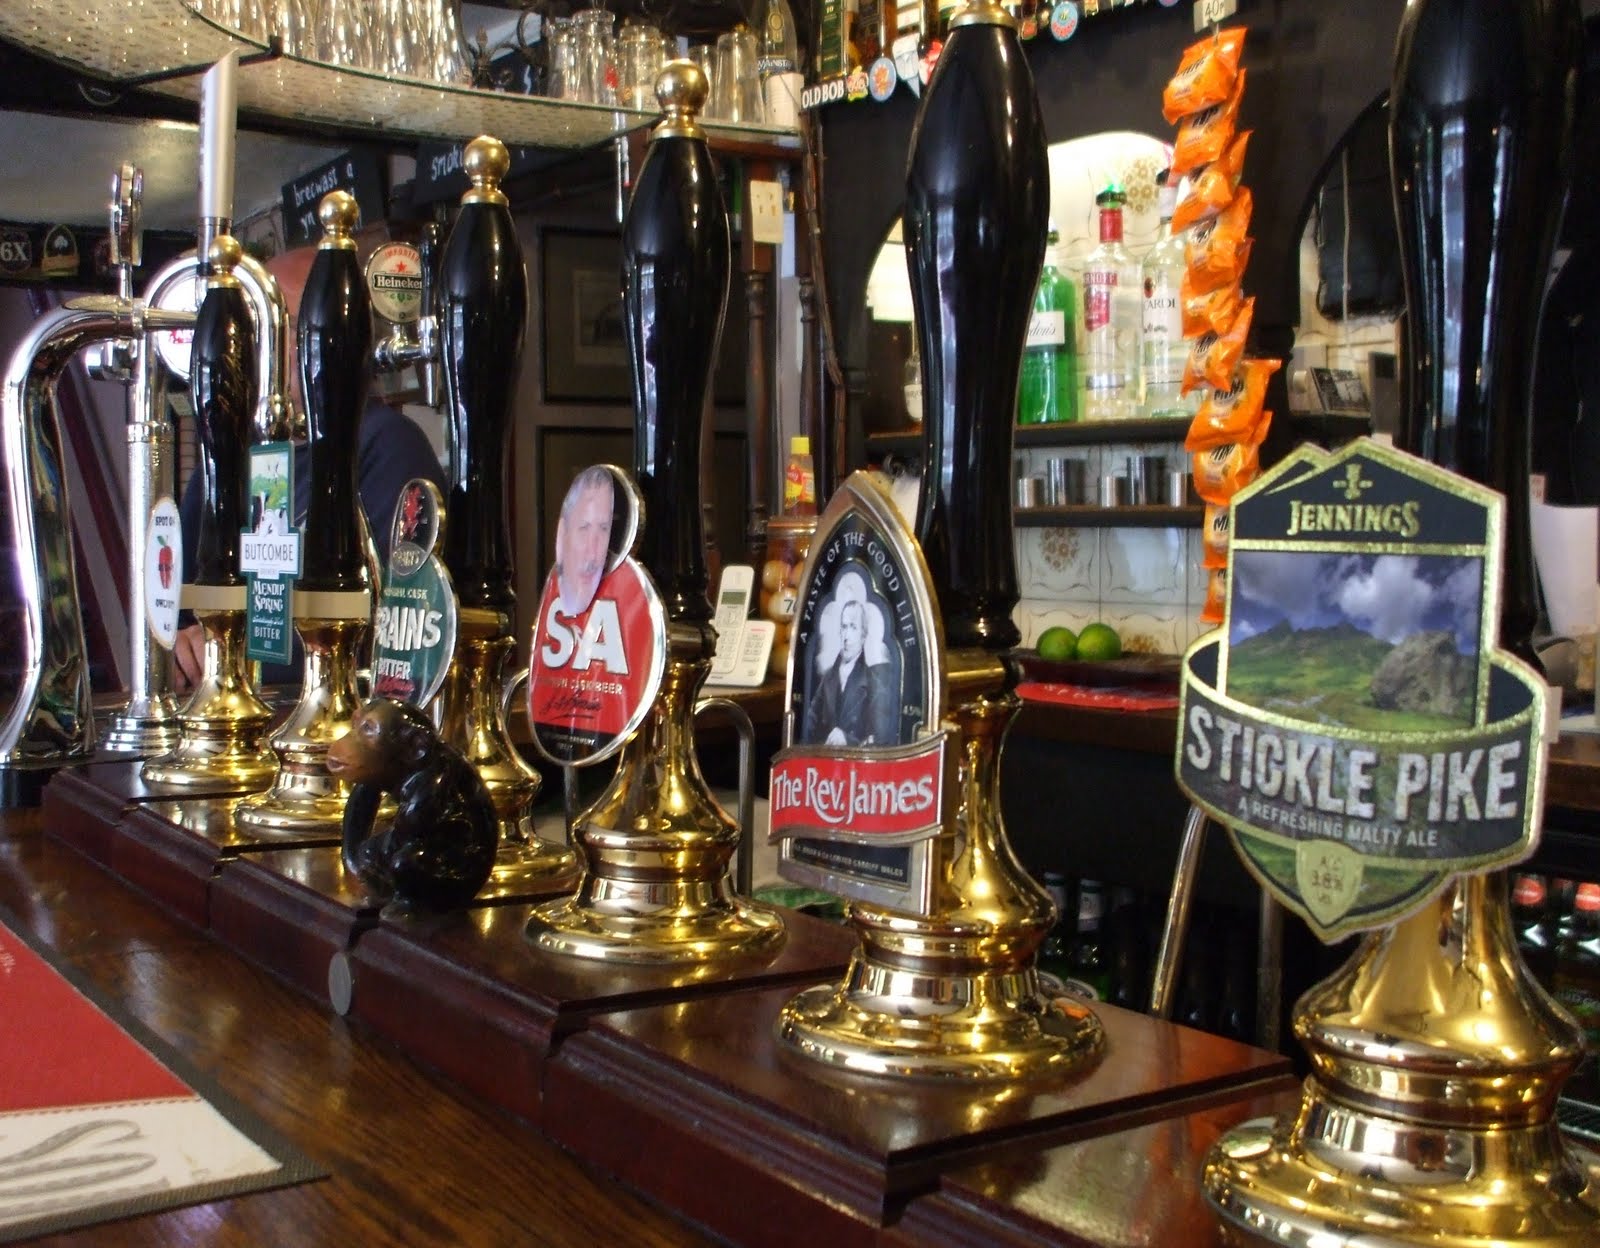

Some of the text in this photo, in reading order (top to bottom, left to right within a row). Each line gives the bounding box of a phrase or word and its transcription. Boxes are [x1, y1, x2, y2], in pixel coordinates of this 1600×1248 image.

[802, 85, 821, 109] OLD
[822, 80, 845, 103] BOB
[0, 241, 28, 261] 6X
[1286, 500, 1420, 538] JENNINGS
[244, 543, 294, 562] BUTCOMBE
[253, 580, 285, 596] MENDIP
[800, 531, 916, 648] A TASTE OF THE GOOD LIFE
[254, 595, 283, 614] SPRING
[254, 626, 280, 640] BITTER
[376, 606, 443, 651] RAINS
[595, 681, 623, 695] BEER
[1186, 705, 1522, 822] STICKLE PIKE
[774, 767, 934, 825] The Rev. James
[1238, 797, 1438, 847] A REFRESHING MALTY ALE
